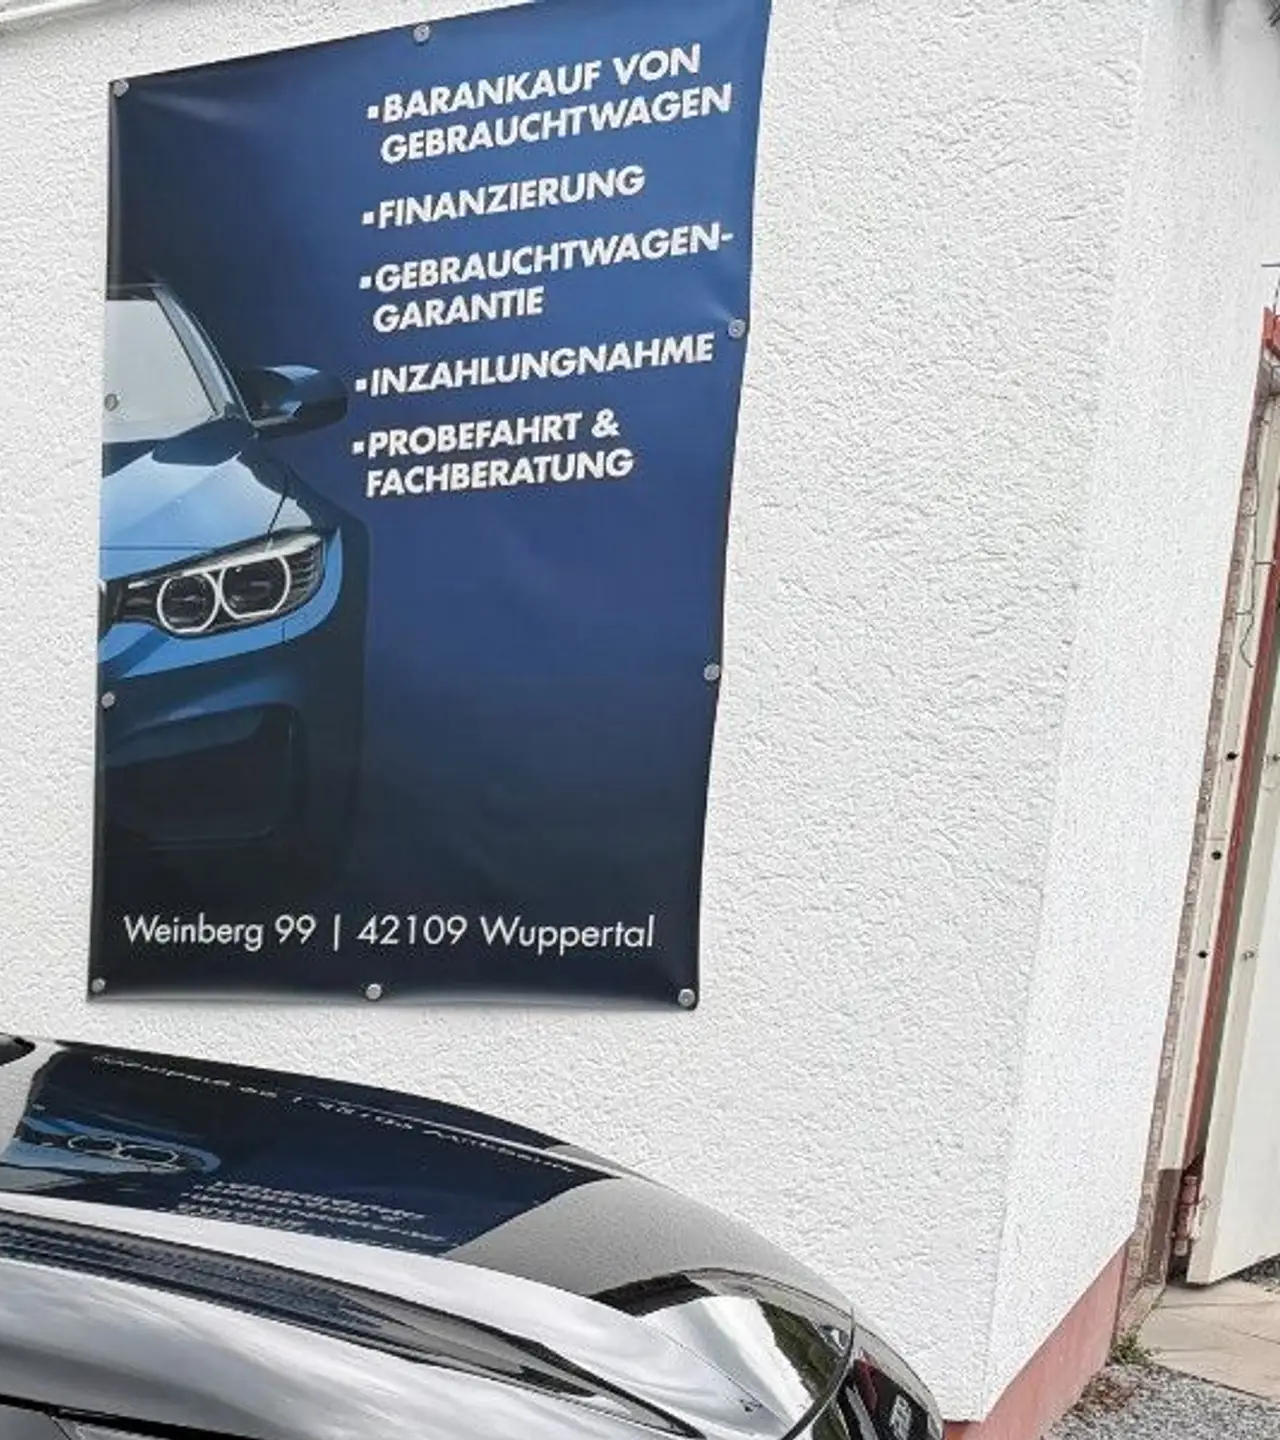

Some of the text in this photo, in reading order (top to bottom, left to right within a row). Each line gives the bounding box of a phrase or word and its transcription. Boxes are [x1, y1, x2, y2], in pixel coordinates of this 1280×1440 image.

[382, 43, 701, 124] BARANKAUF VON
[380, 83, 733, 164] GEBRAUCHTWAGEN
[378, 165, 646, 229] FINANZIERUNG
[375, 222, 734, 293] GEBRAUCHTWAGEN-
[373, 286, 545, 333] GARANTIE
[370, 333, 716, 397] INZAHLUNGNAHME
[368, 408, 621, 458] PROBEFAHRT &
[366, 448, 636, 498] FACHBERATUNG
[123, 912, 264, 952] Weinberg
[275, 915, 317, 945] 99
[356, 915, 468, 946] 42109
[480, 914, 655, 956] Wuppertal
